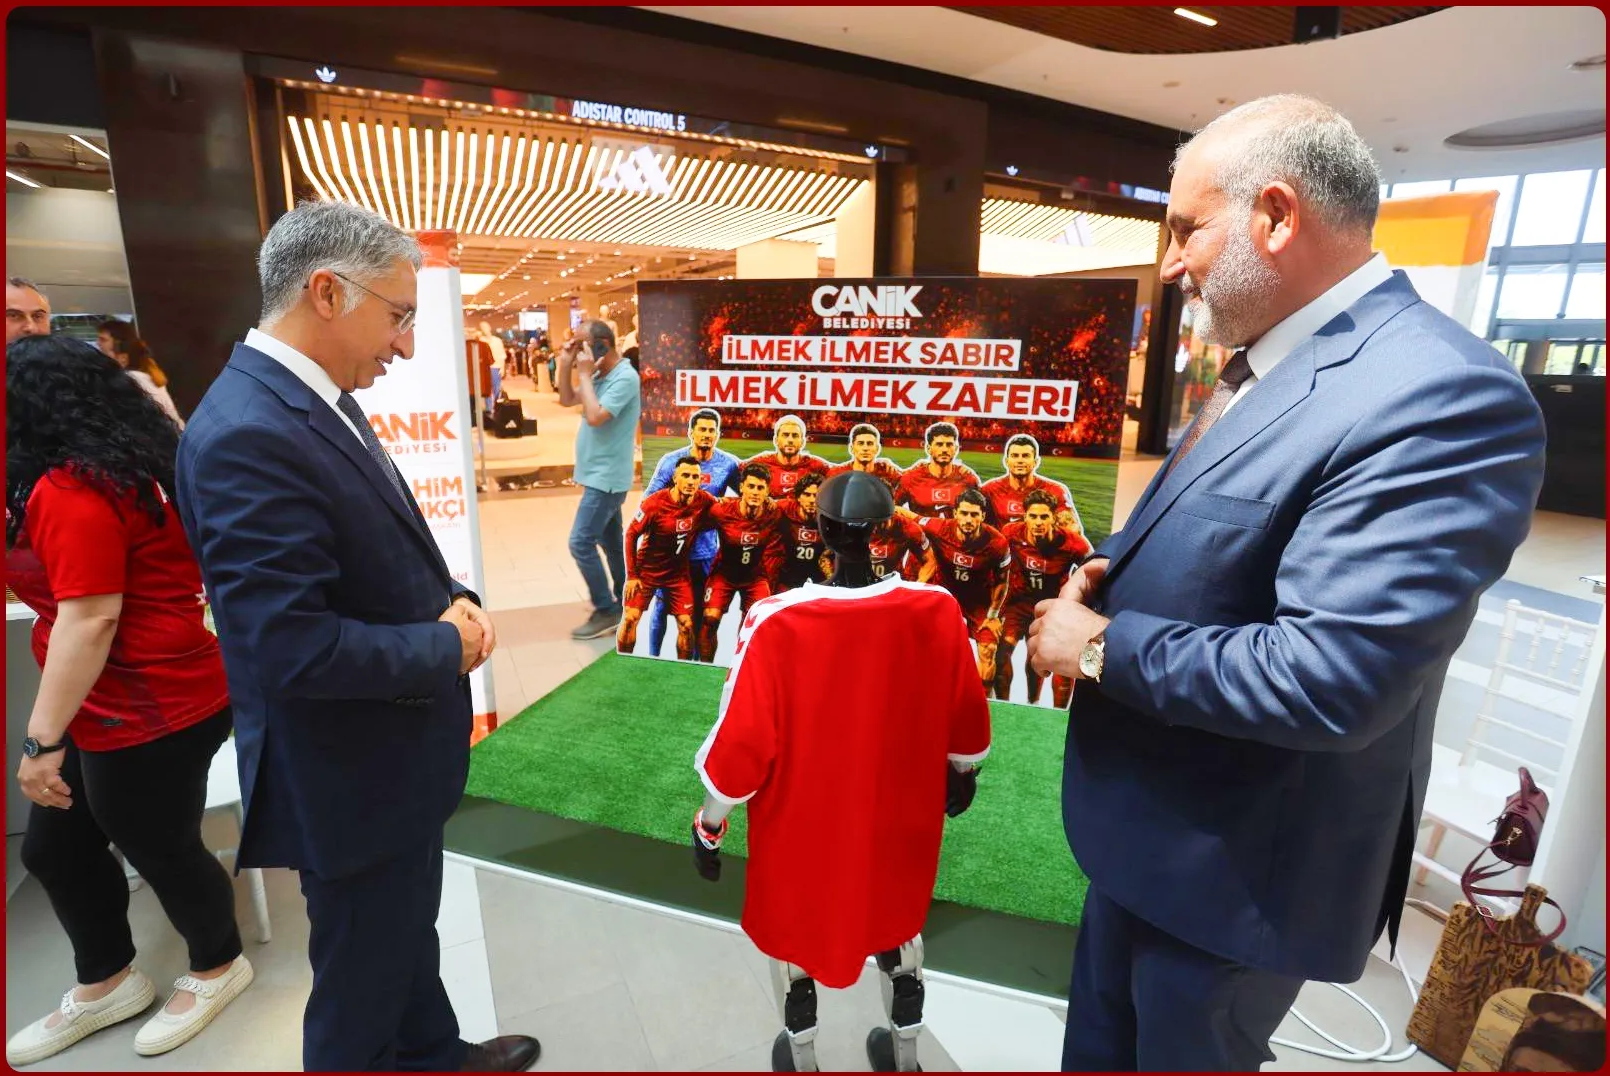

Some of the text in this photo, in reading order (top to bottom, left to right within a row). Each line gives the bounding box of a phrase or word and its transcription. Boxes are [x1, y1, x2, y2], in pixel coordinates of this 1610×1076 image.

[572, 100, 686, 131] ADISTAR CONTROL 5
[920, 342, 1015, 367] SABIR
[926, 381, 1072, 418] ZAFER!
[368, 412, 457, 442] ANİK
[675, 540, 685, 555] 7
[796, 546, 815, 560] 20
[741, 552, 751, 565] 8
[954, 569, 970, 582] 16
[1029, 576, 1043, 590] 11
[704, 588, 712, 602] 8
